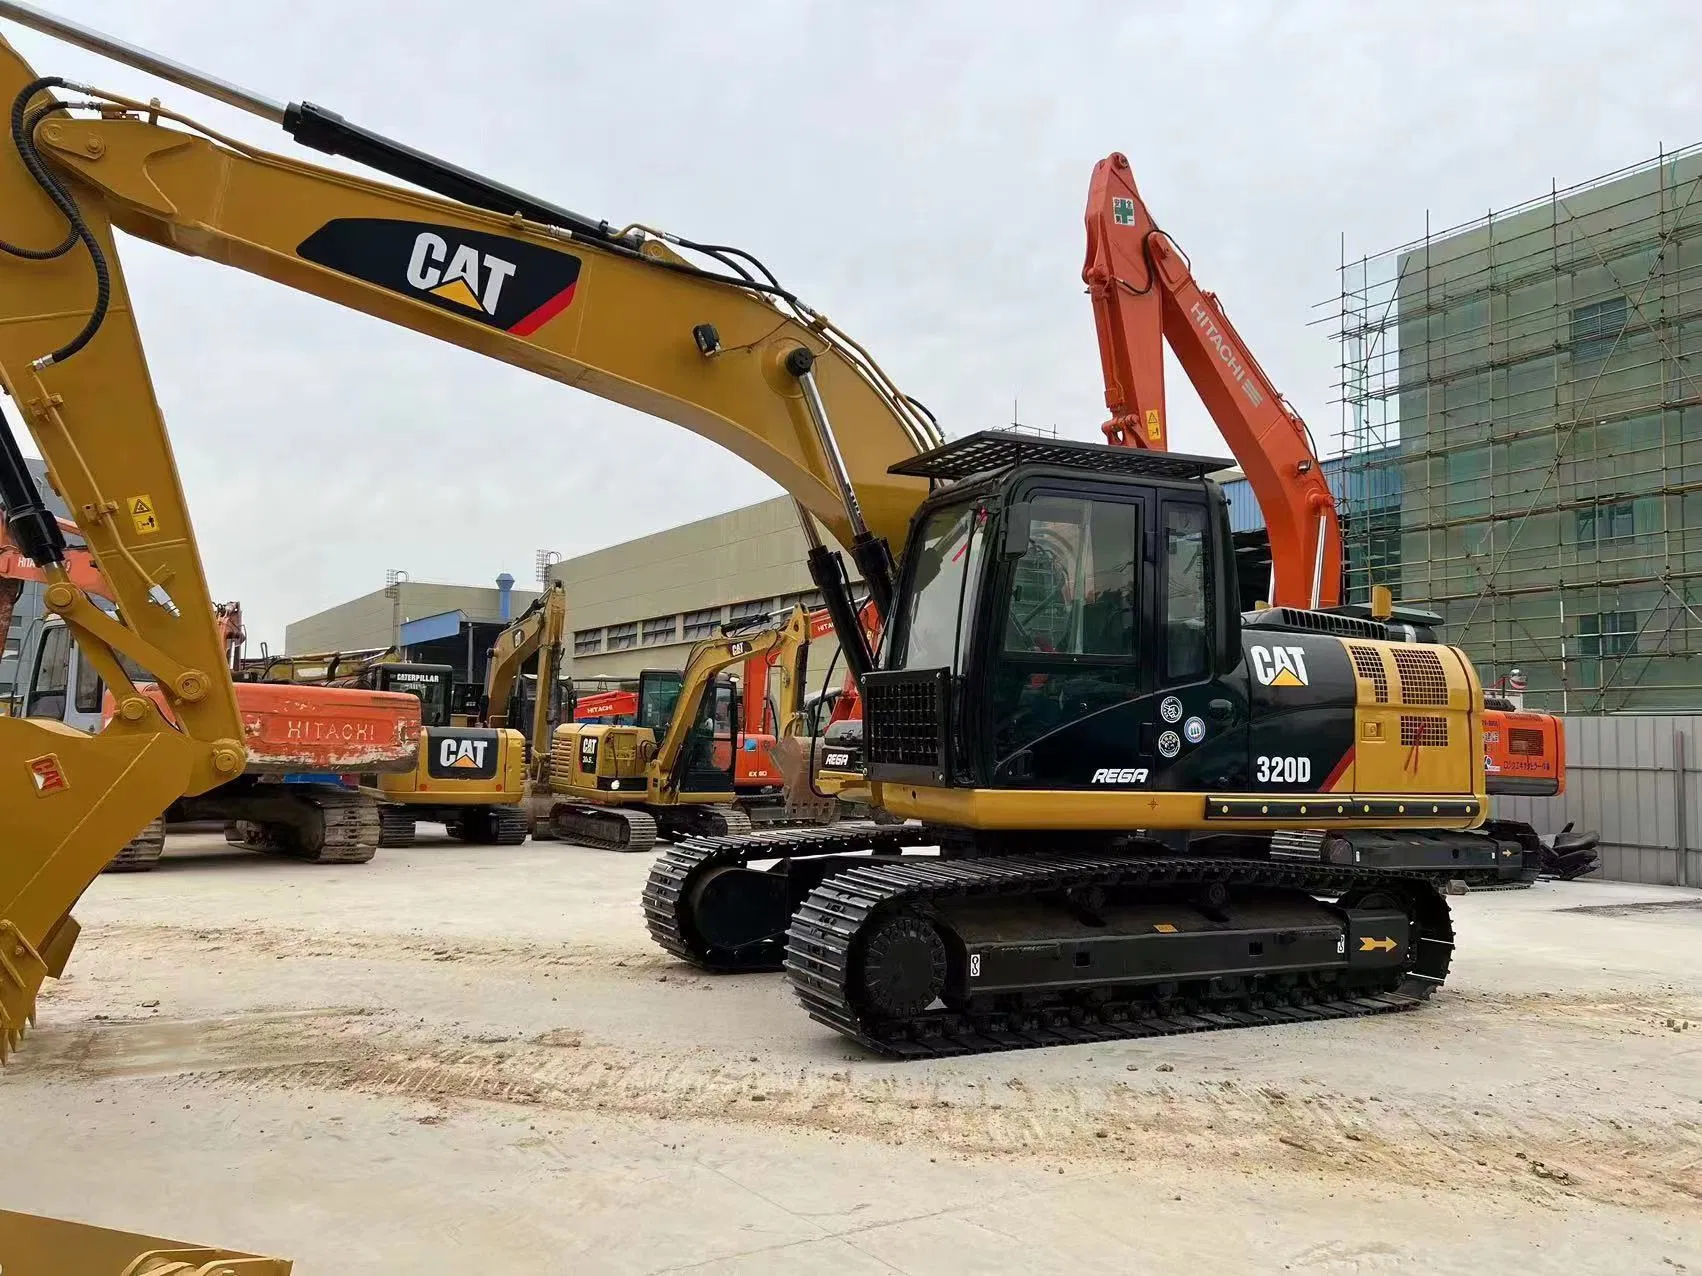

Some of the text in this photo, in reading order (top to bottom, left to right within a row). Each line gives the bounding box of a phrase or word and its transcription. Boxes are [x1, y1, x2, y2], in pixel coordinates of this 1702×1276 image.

[406, 232, 517, 316] CAT
[1190, 302, 1246, 382] HITACHI
[731, 643, 744, 656] CAT
[1250, 645, 1309, 686] CAT
[397, 673, 439, 683] CATERPILLAR
[587, 705, 613, 714] HITACHI
[287, 720, 374, 740] HITACHI
[440, 738, 488, 769] CAT
[582, 738, 597, 754] CAT
[825, 753, 849, 766] REGA
[1091, 768, 1149, 784] REGA
[1256, 756, 1311, 783] 320D
